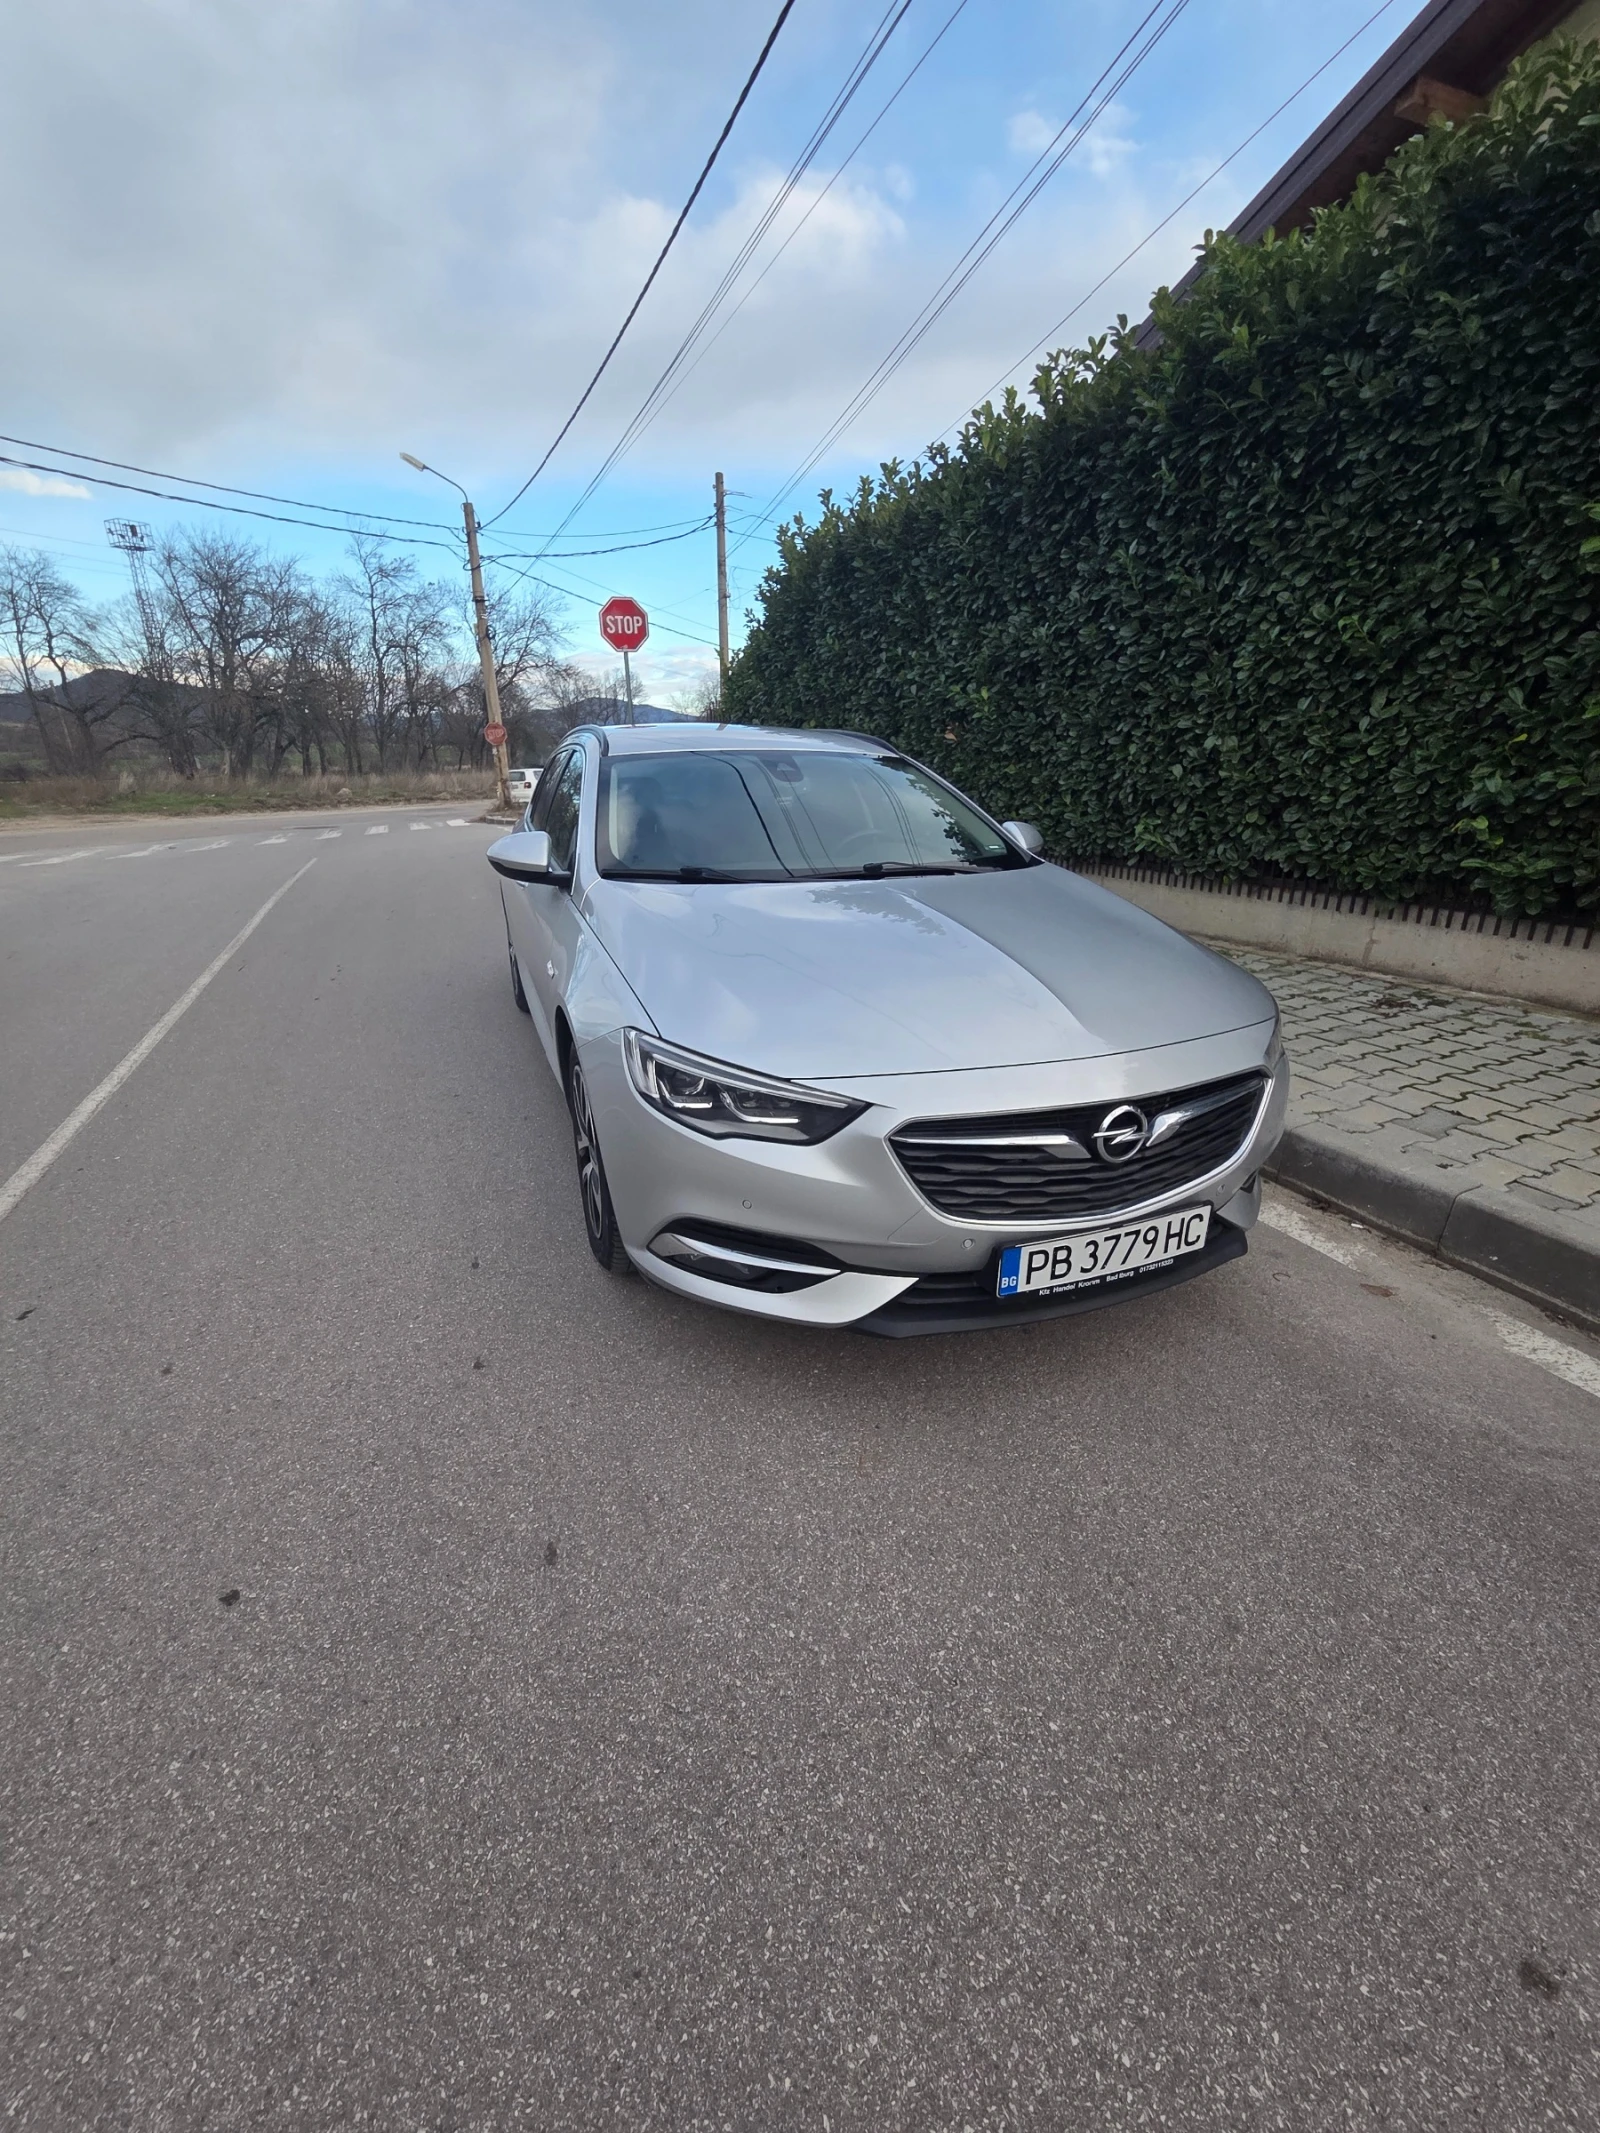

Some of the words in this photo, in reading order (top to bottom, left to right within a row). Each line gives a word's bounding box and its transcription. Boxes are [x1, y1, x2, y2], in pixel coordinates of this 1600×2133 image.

[606, 615, 643, 634] STOP
[487, 728, 505, 740] STOP
[1025, 1246, 1072, 1285] PB
[1080, 1225, 1159, 1273] 3779
[1163, 1213, 1204, 1254] HC
[1001, 1277, 1017, 1288] BG
[1053, 1282, 1076, 1293] Handel
[1106, 1273, 1119, 1282] Bad
